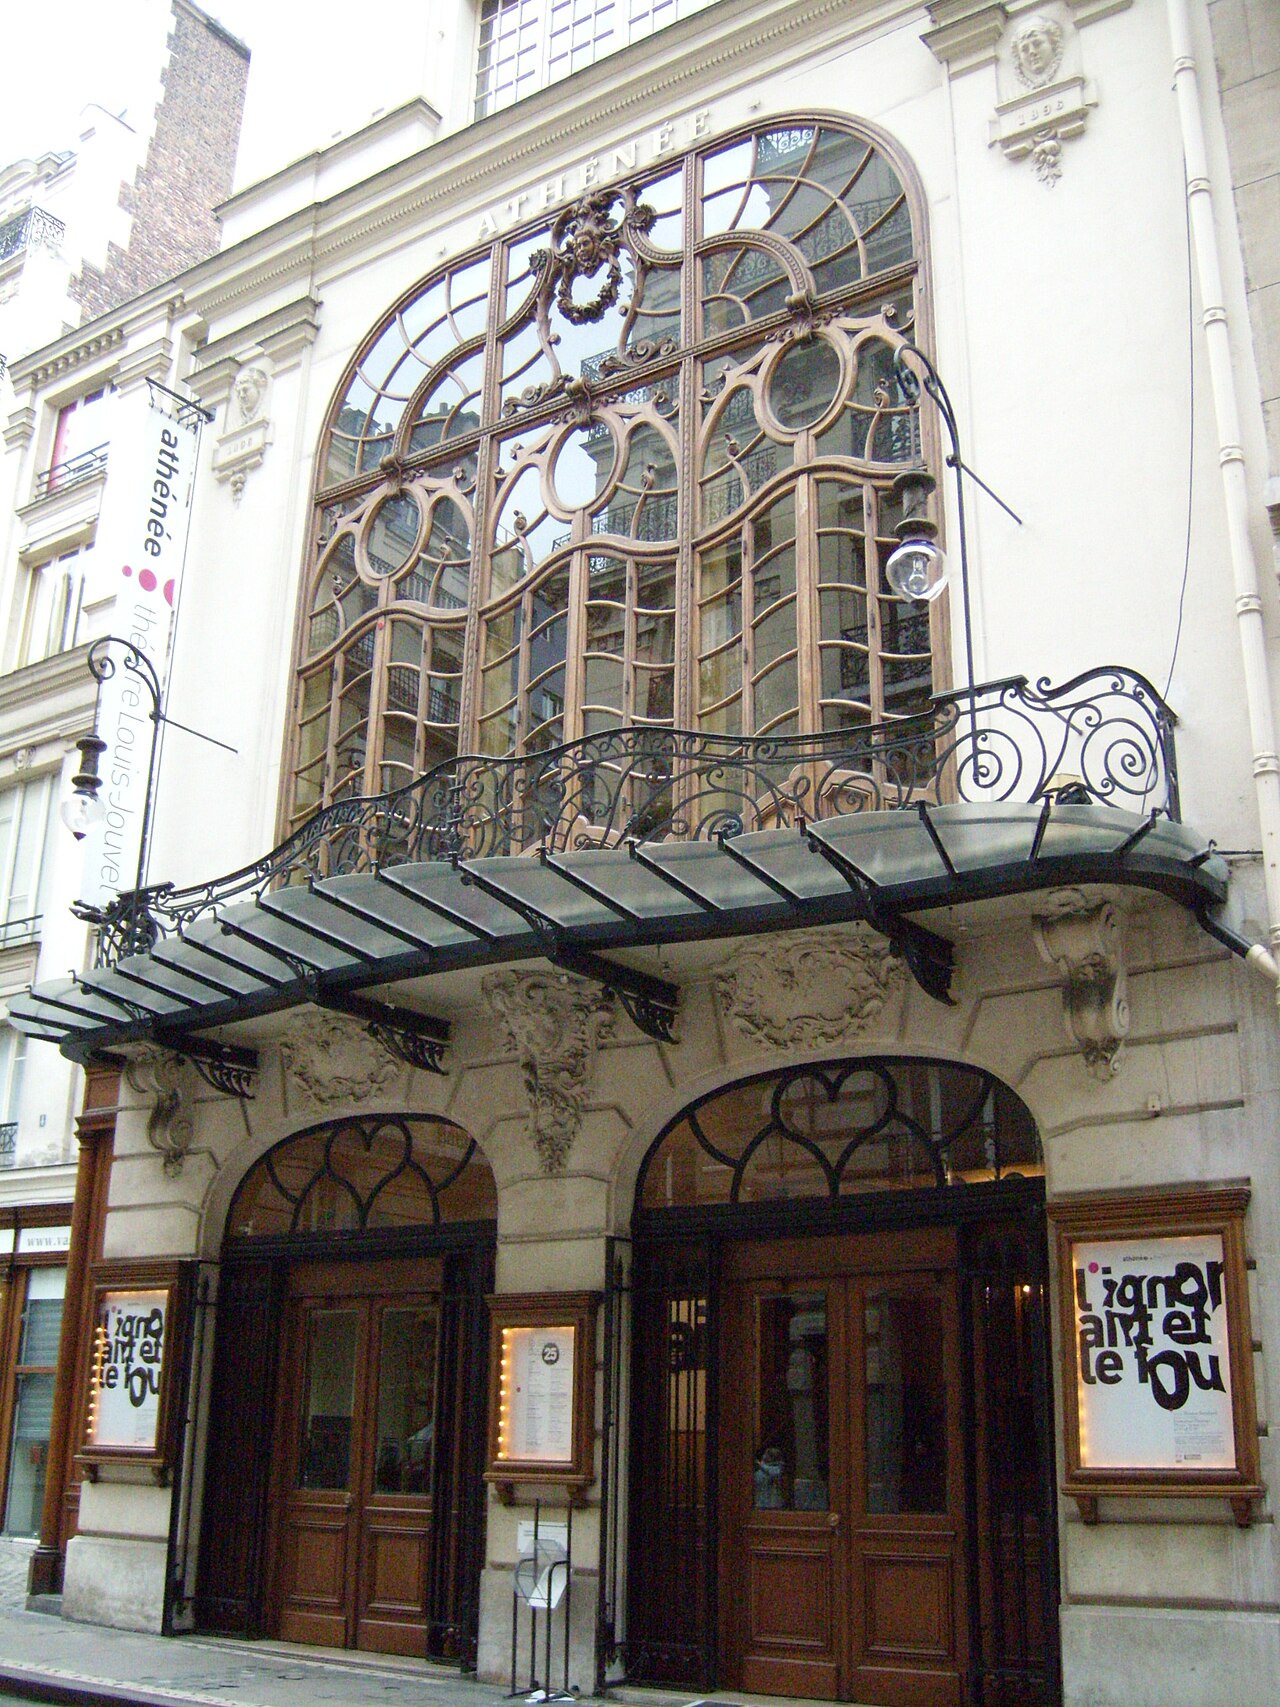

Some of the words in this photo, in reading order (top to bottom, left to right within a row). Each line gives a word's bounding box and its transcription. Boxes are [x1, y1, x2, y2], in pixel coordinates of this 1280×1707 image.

[478, 108, 711, 241] ATHÉNÉE
[144, 428, 180, 557] athénée
[99, 712, 145, 894] Louis-Jouvet
[140, 1338, 162, 1364] et
[1078, 1306, 1154, 1348] ant
[1162, 1309, 1212, 1345] et
[1080, 1344, 1124, 1385] le
[1134, 1344, 1227, 1411] fou
